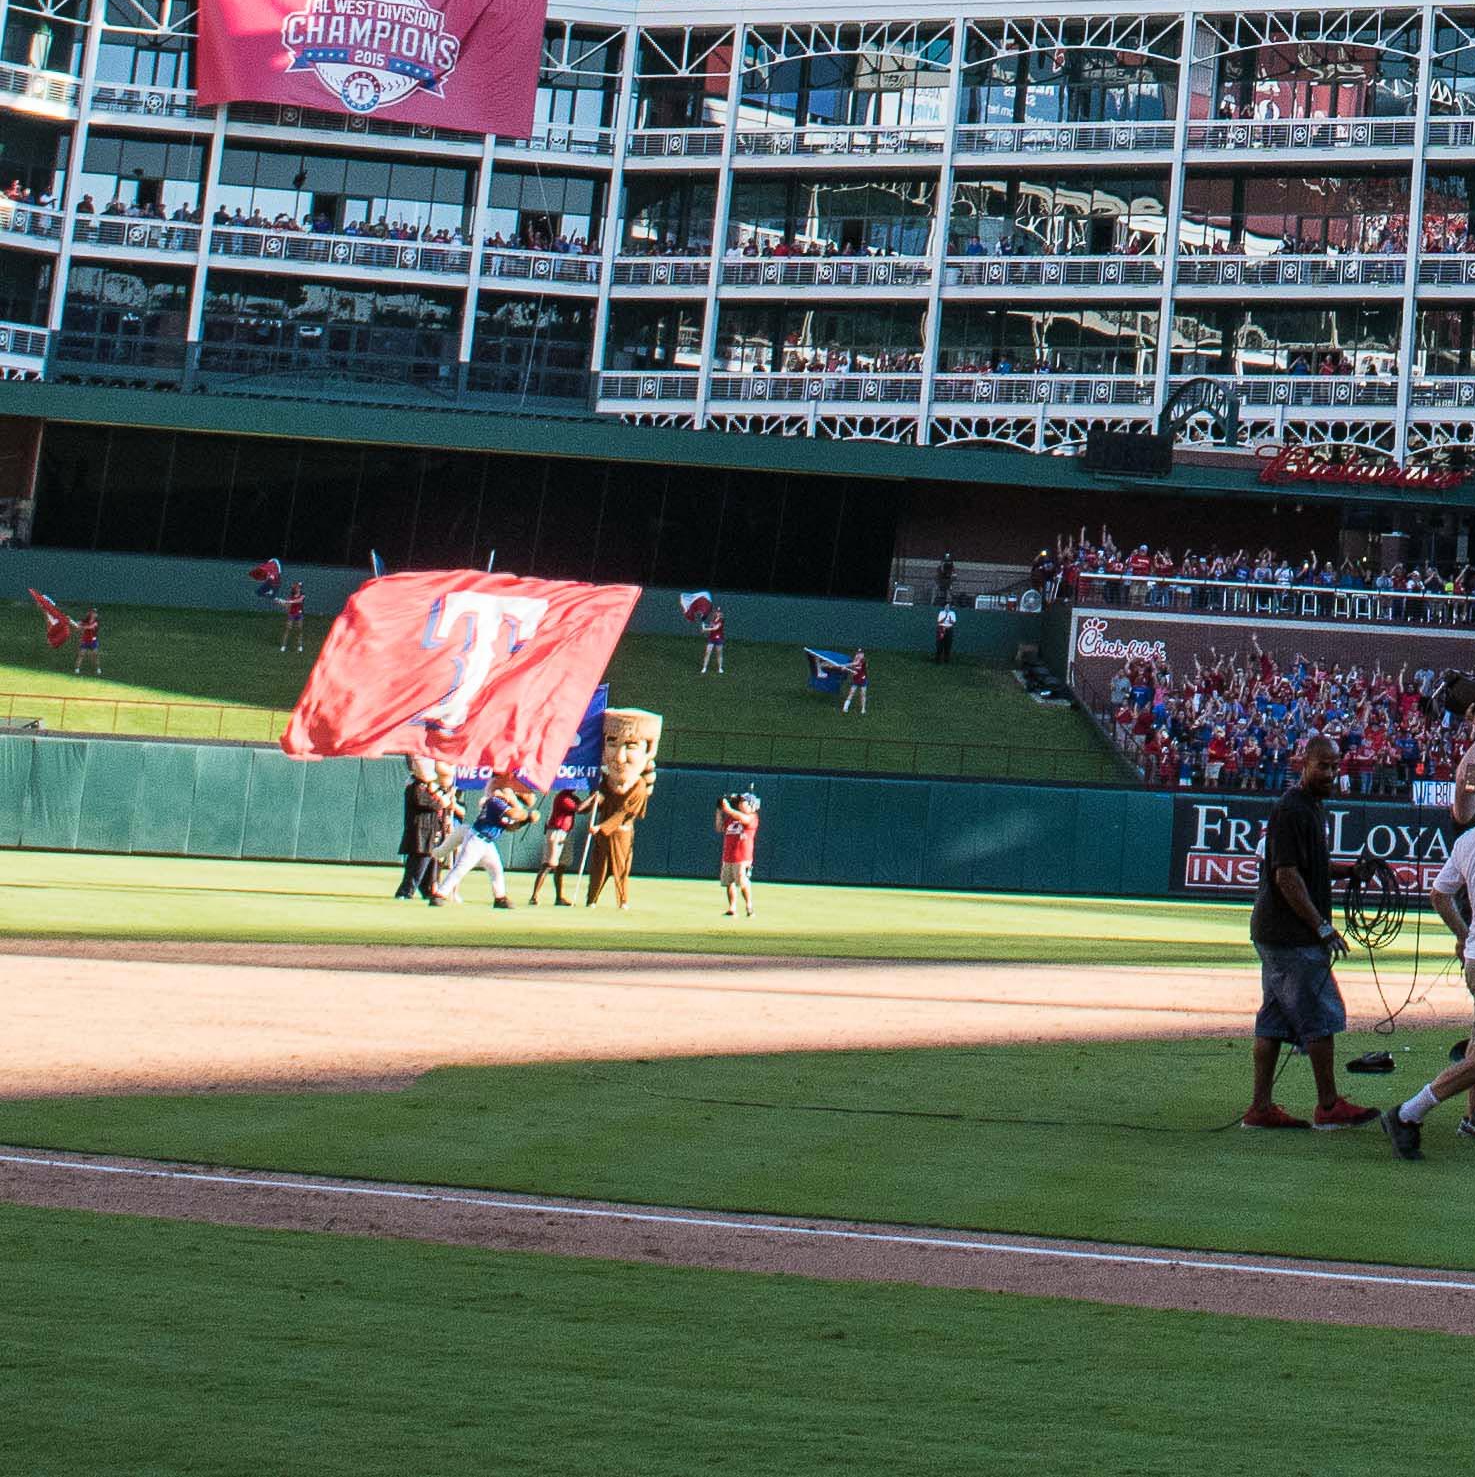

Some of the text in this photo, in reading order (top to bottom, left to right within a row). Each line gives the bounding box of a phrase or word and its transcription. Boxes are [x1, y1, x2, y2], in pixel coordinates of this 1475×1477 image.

[311, 0, 439, 32] AL WEST DIVISION
[286, 14, 458, 71] CHAMPIONS
[353, 49, 386, 67] 2015
